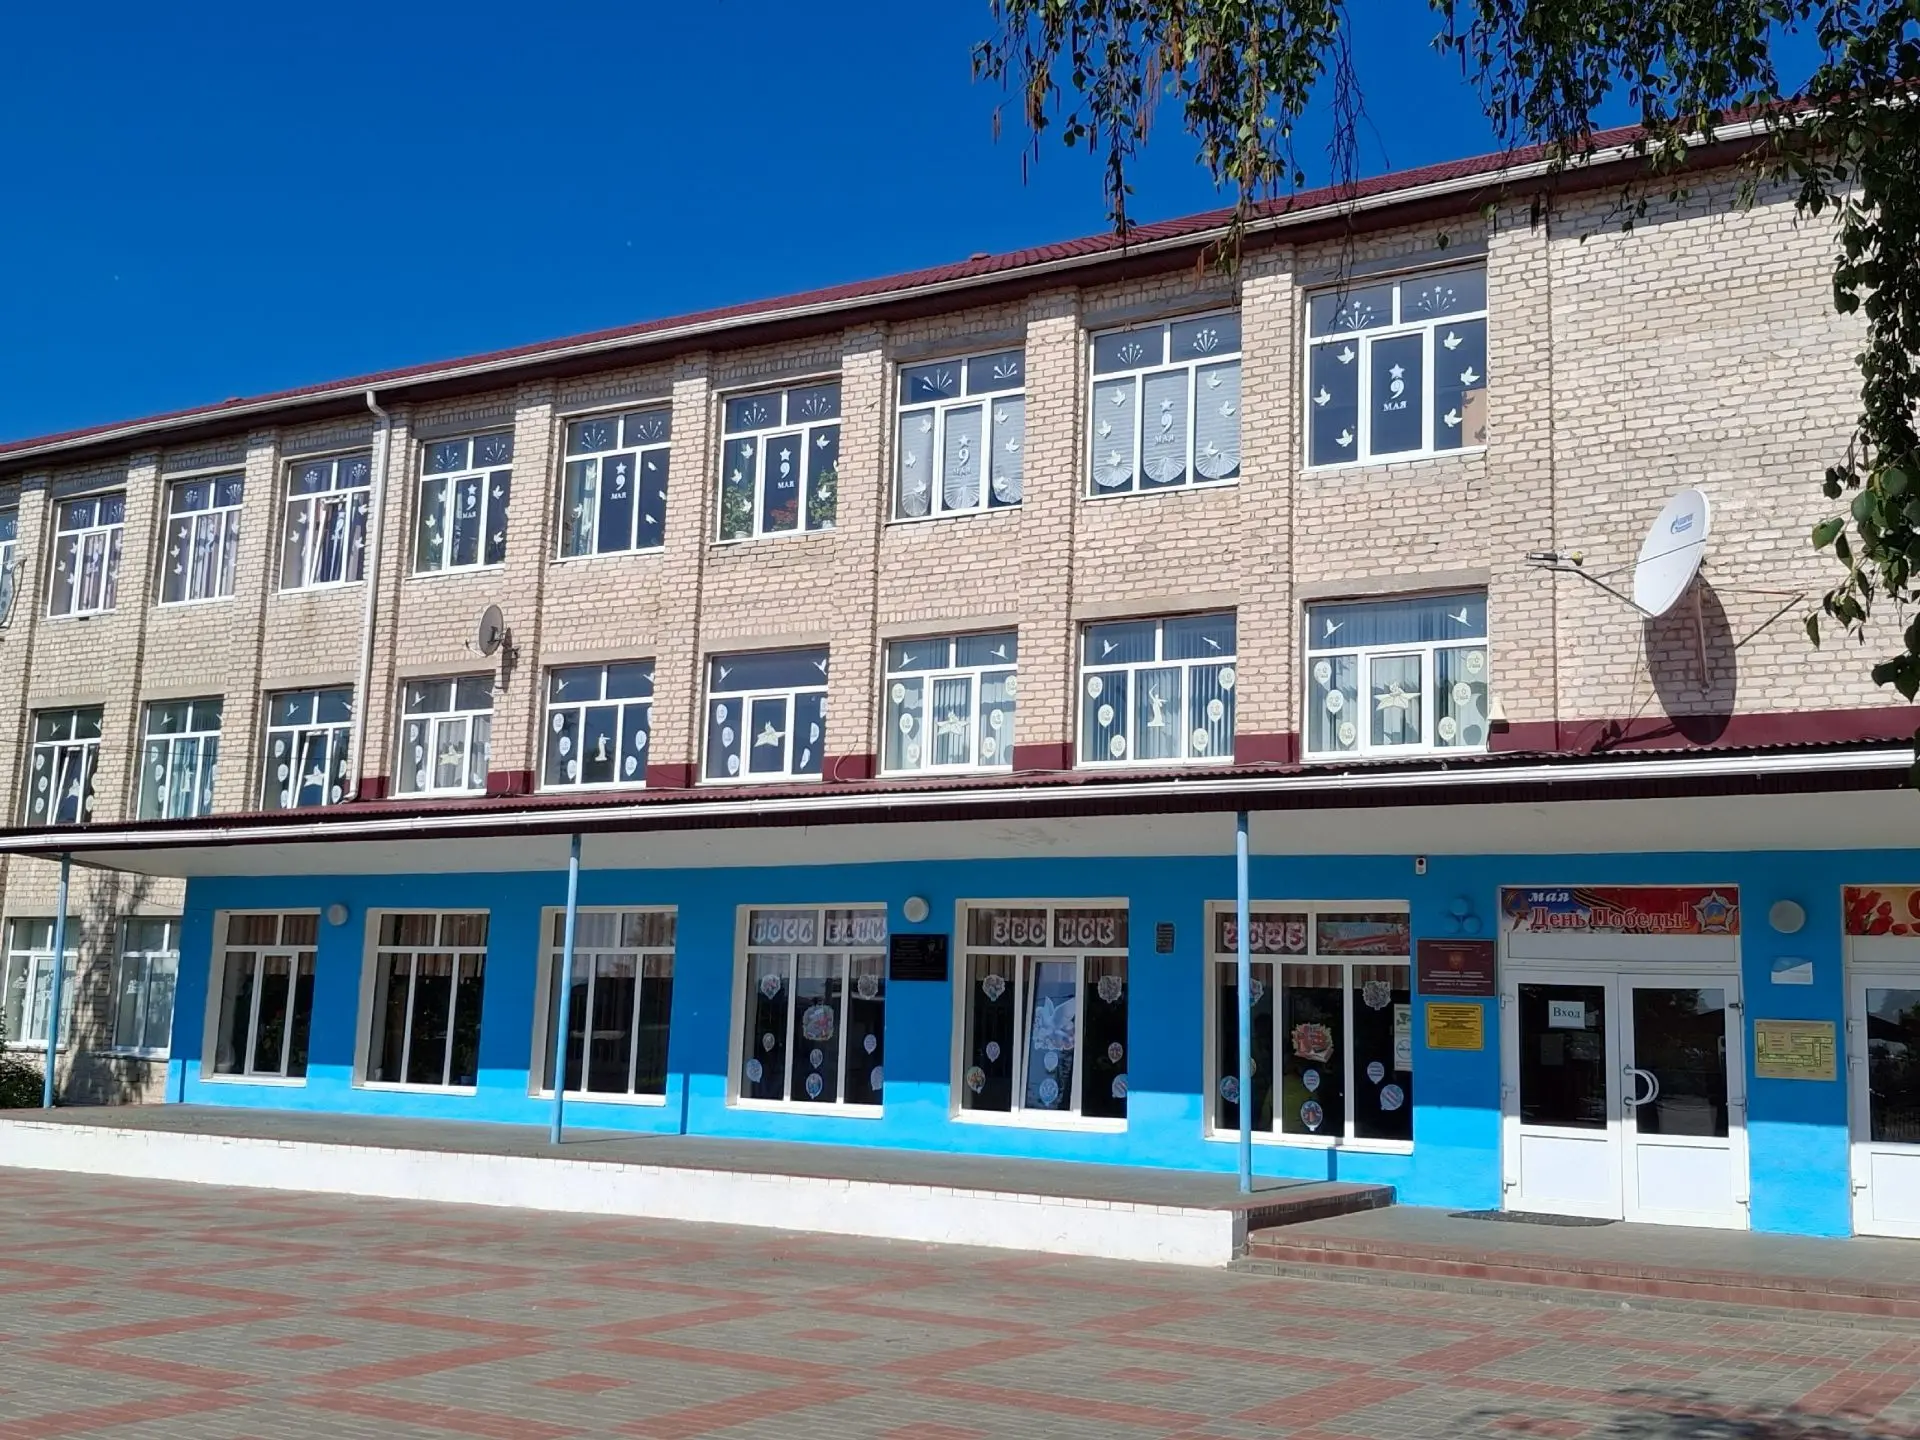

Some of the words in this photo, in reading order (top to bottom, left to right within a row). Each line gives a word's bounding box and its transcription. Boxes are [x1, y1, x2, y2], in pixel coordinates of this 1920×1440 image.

[1390, 379, 1404, 399] 9
[1383, 400, 1407, 411] МАЯ
[1161, 413, 1173, 433] 9
[958, 448, 970, 467] 9
[780, 461, 790, 479] 9
[615, 474, 625, 491] 9
[466, 495, 476, 511] 9
[1528, 892, 1570, 902] мая
[1530, 906, 1587, 931] День
[1590, 902, 1690, 931] Победы!
[1553, 1006, 1581, 1018] Вход
